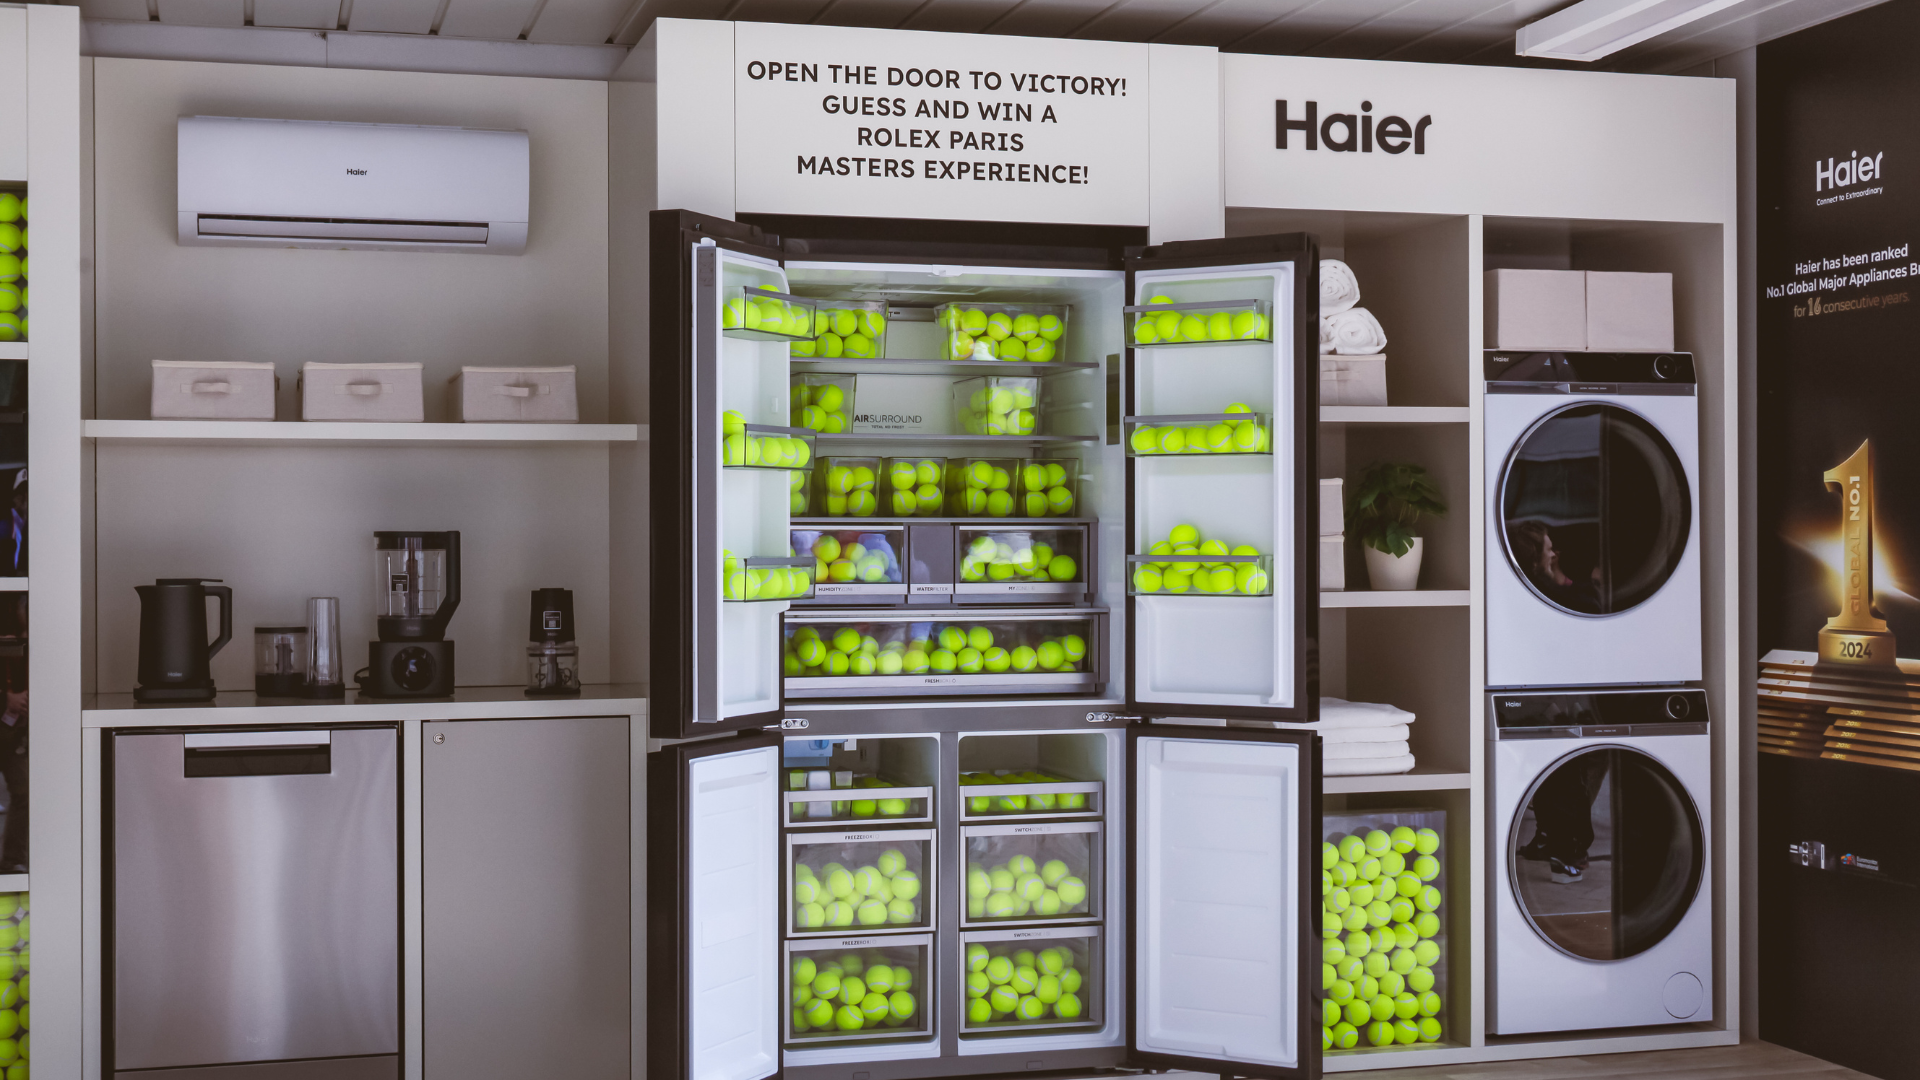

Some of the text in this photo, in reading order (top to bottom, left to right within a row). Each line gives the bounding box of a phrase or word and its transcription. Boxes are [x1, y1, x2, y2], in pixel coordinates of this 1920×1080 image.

[748, 61, 1126, 97] OPEN THE DOOR TO VICTORY!
[823, 95, 1057, 123] GUESS AND WIN A
[858, 128, 1024, 152] ROLEX PARIS
[1275, 99, 1433, 155] Haier
[346, 168, 368, 176] Haier
[798, 156, 1088, 185] MASTERS EXPERIENCE!
[1816, 150, 1883, 192] Haier
[1816, 195, 1838, 206] Connect
[1845, 186, 1884, 200] Extraordinary
[1795, 243, 1909, 276] Haier has been ranked
[1766, 285, 1785, 299] No.1
[1786, 278, 1817, 296] Global
[1819, 275, 1848, 292] Major
[1849, 267, 1908, 288] Appliances
[1793, 305, 1806, 318] for
[1808, 296, 1822, 317] 16
[1823, 294, 1880, 314] consecutive
[1849, 475, 1862, 616] GLOBAL NO.1
[1839, 641, 1873, 659] 2024
[1505, 700, 1522, 708] Haier
